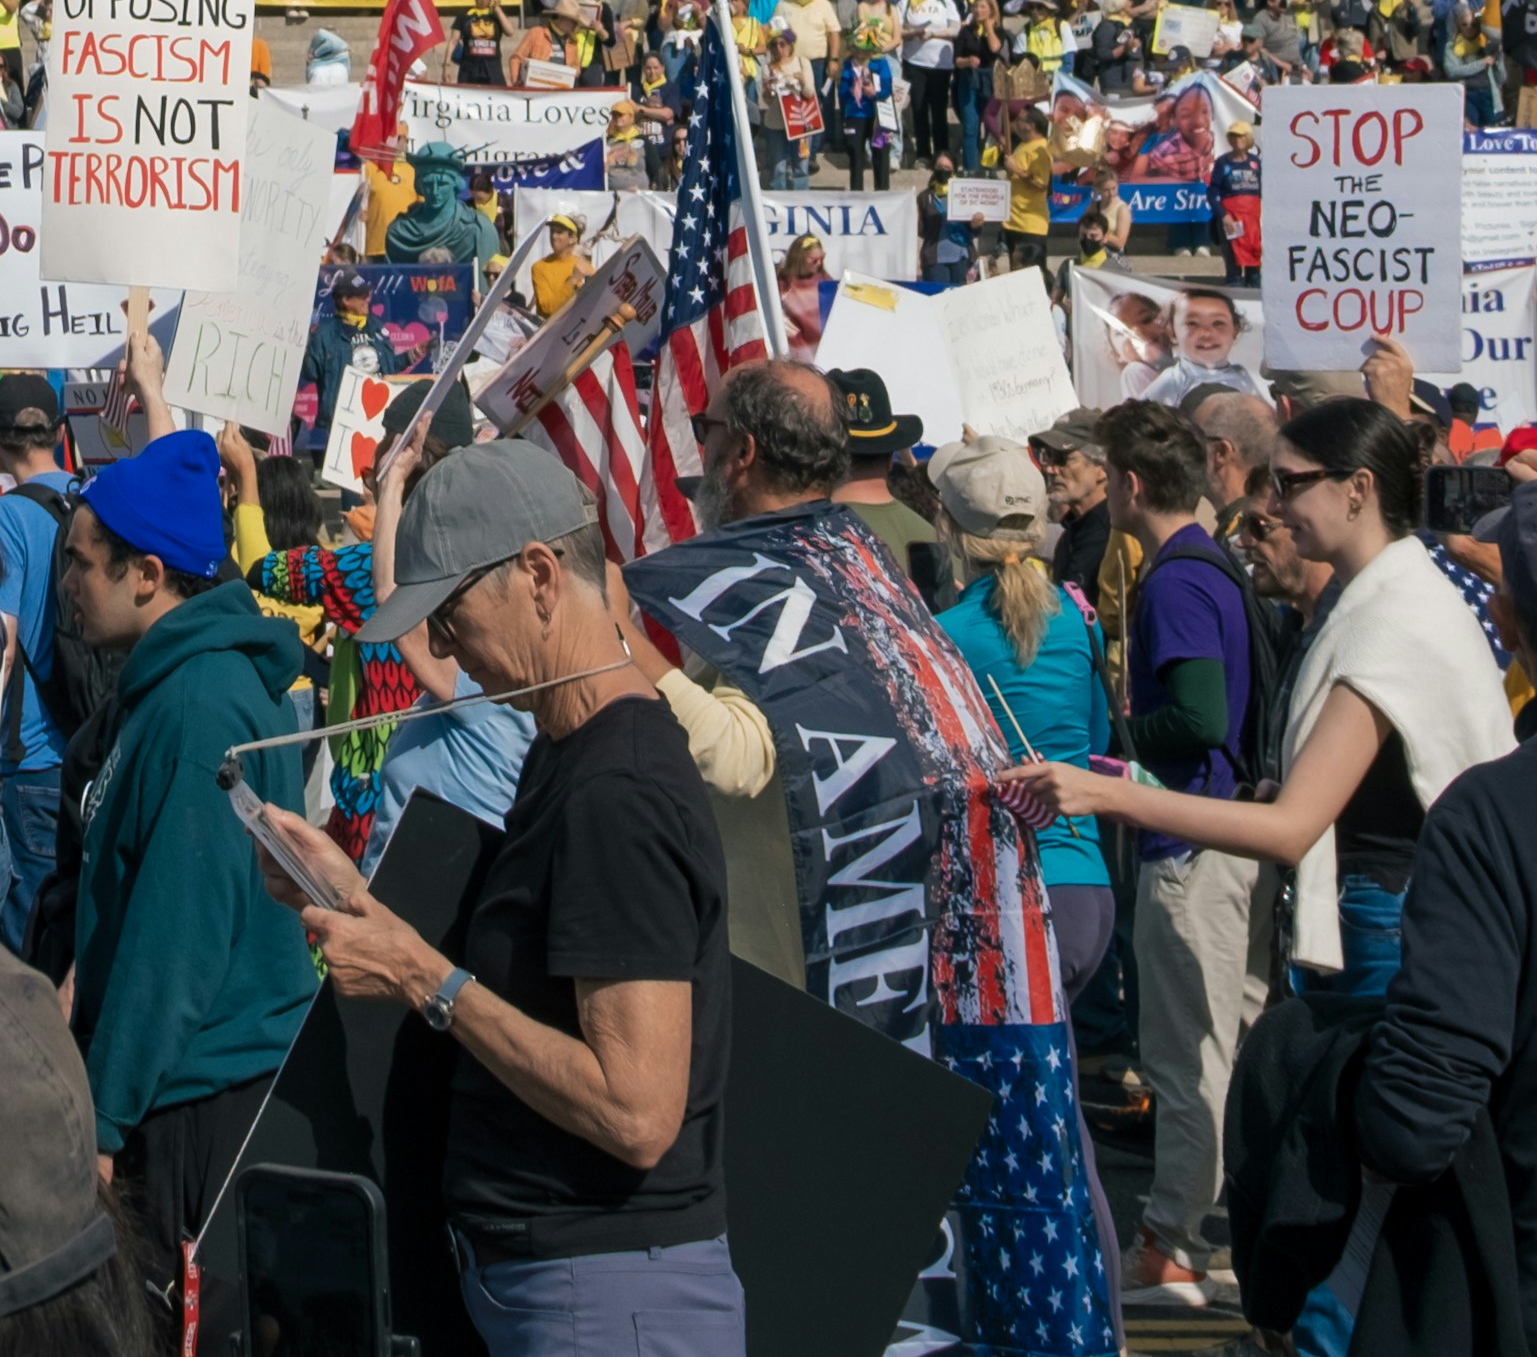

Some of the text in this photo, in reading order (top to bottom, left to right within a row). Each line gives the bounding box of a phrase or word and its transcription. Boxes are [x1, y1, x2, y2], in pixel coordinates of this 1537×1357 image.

[61, 31, 231, 86] FASCISM
[69, 94, 235, 152] IS NOT
[524, 96, 609, 125] Loves
[1289, 106, 1424, 169] STOP
[1469, 133, 1514, 151] Love
[50, 151, 240, 214] TERRORISM
[1129, 190, 1166, 211] Are
[1334, 174, 1383, 194] THE
[244, 174, 322, 248] NORITY
[1309, 199, 1415, 240] NEO-
[1287, 245, 1435, 285] FASCIST
[1295, 287, 1424, 335] COUP
[185, 320, 288, 416] RICH
[73, 388, 98, 406] NO
[669, 553, 848, 674] IN
